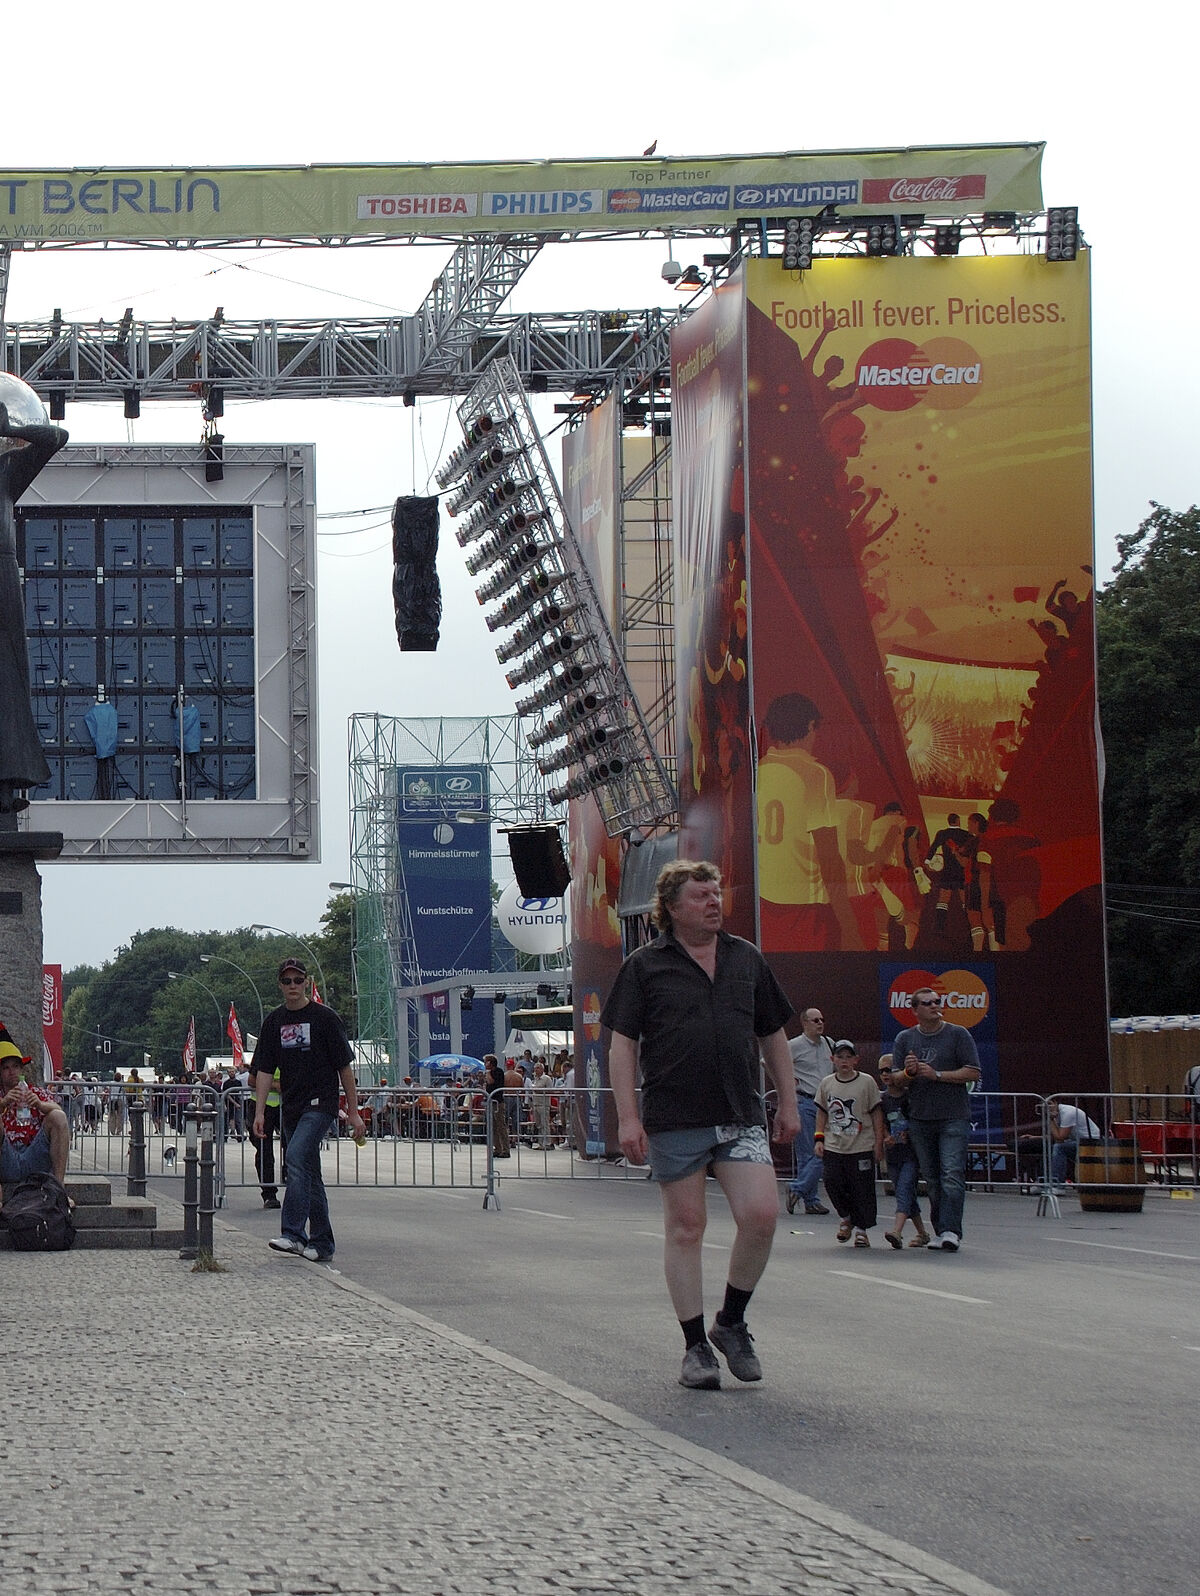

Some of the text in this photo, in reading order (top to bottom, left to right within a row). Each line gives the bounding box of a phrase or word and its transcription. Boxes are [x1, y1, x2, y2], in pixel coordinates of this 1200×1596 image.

[629, 168, 711, 183] Top Partner
[43, 178, 221, 215] BERLIN
[765, 185, 857, 203] HYUNDAI
[888, 176, 961, 201] Coca-Cola
[366, 197, 468, 216] TOSHIBA
[491, 191, 594, 214] PHILIPS
[641, 190, 728, 208] MasterCard
[13, 224, 45, 236] WM
[771, 296, 1066, 329] Football fever. Priceless.
[858, 363, 982, 386] MasterCard
[408, 848, 480, 859] Himmelsstürmer
[416, 905, 474, 916] Kunstschütze
[890, 991, 987, 1009] MarCard
